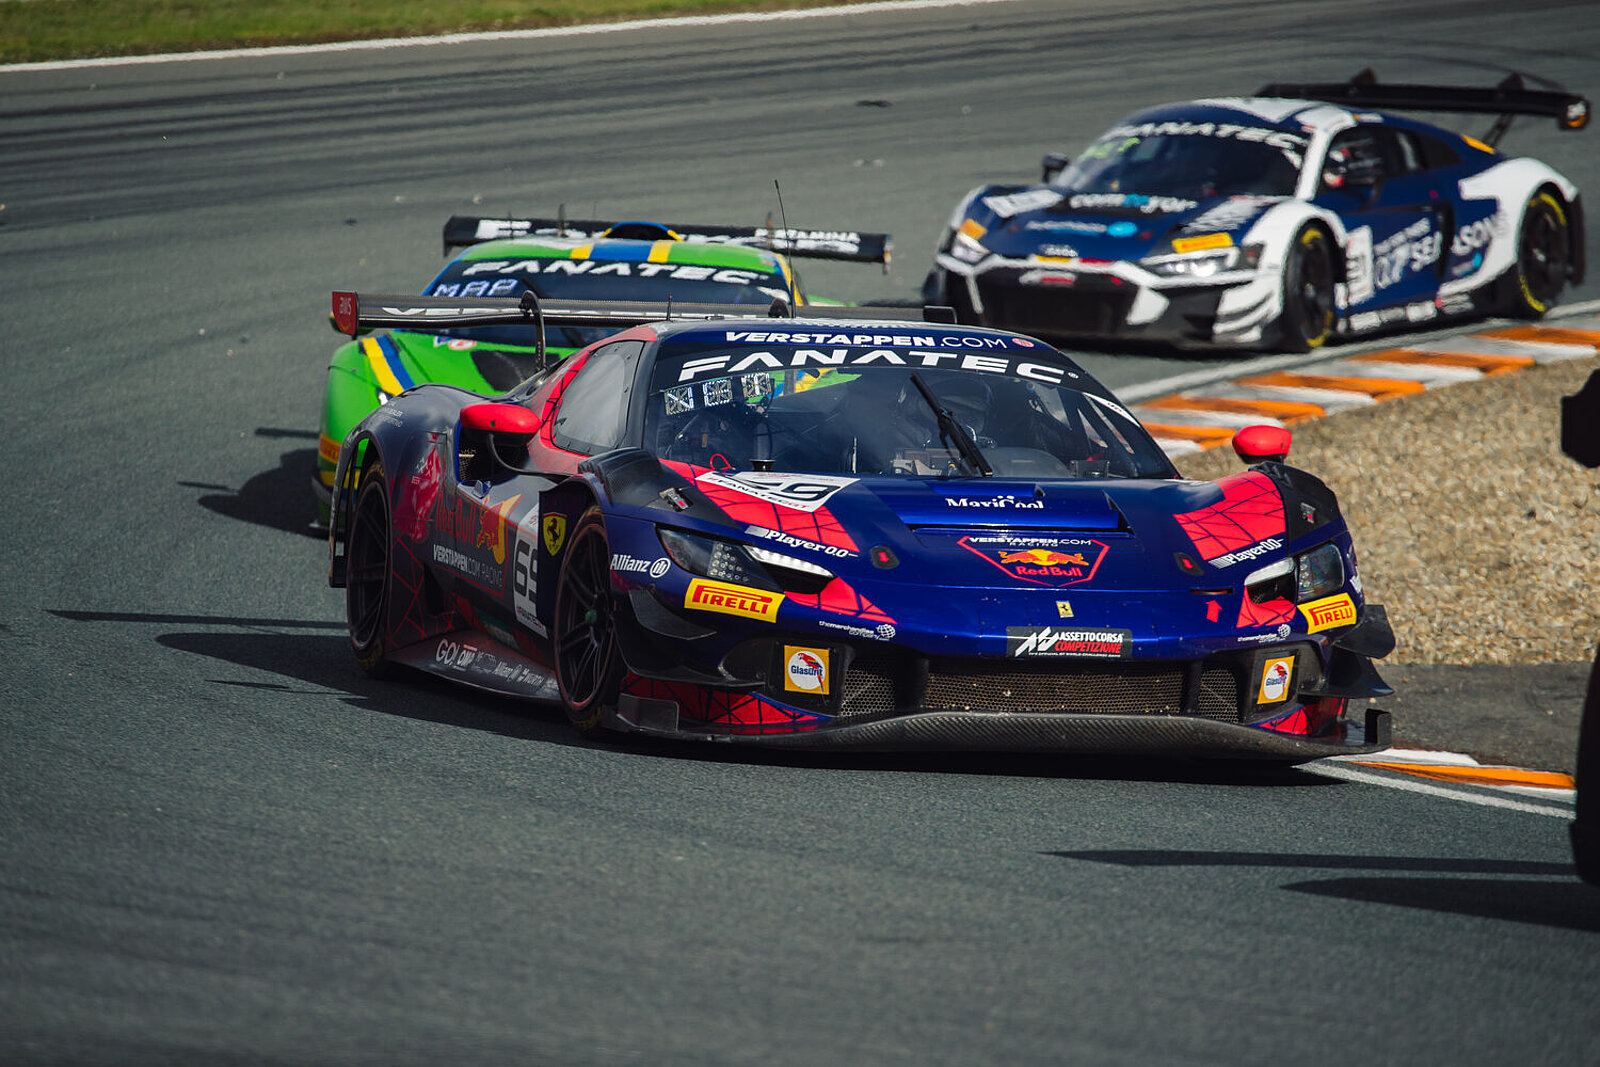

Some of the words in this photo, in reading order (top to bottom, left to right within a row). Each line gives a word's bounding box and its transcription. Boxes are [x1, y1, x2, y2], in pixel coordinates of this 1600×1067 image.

[462, 259, 759, 285] FANATEC
[725, 331, 1008, 349] VERSTAPPEN.COM
[677, 349, 1066, 384] FANATEC
[968, 537, 1092, 546] VERSTAPPEN.COM
[610, 553, 651, 573] Allianz
[691, 585, 773, 614] PIRELLI
[1308, 601, 1353, 626] PIRELLI
[1054, 640, 1122, 653] COMPETIZIONE
[1058, 631, 1096, 642] ASSETTO
[1096, 632, 1123, 643] CORSA
